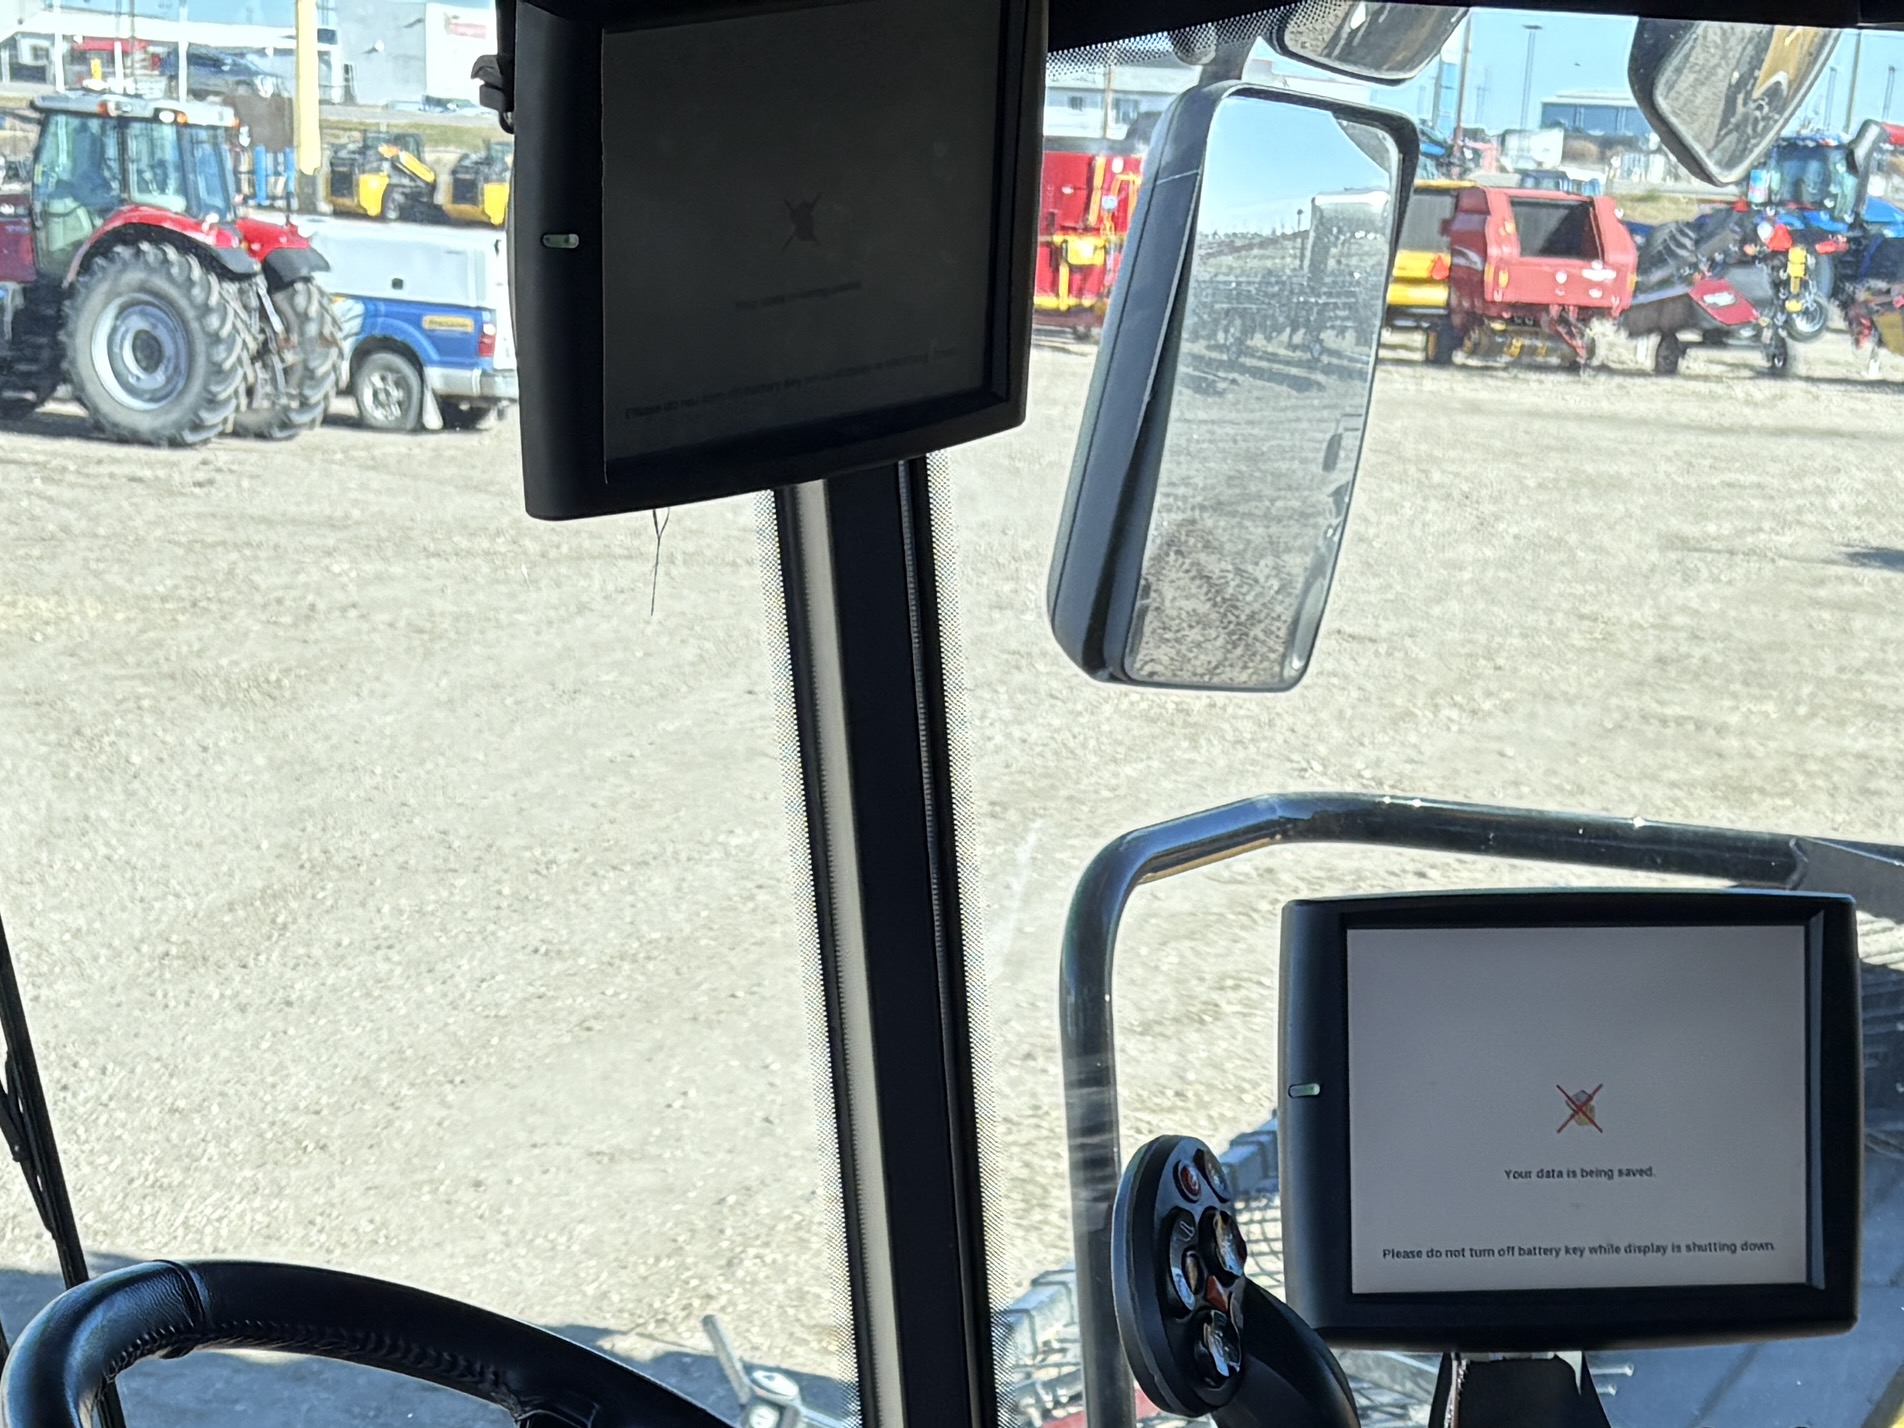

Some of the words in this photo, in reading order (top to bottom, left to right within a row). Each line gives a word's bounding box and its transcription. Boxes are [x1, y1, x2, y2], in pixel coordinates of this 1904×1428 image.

[1504, 1168, 1532, 1180] Your
[1536, 1167, 1564, 1179] data
[1566, 1167, 1577, 1179] is
[1580, 1166, 1614, 1181] being
[1617, 1165, 1657, 1179] saved.
[1382, 1248, 1423, 1260] Please
[1426, 1247, 1443, 1259] do
[1445, 1246, 1466, 1259] not
[1469, 1246, 1495, 1258] turn
[1498, 1245, 1516, 1258] off
[1518, 1244, 1561, 1259] battery
[1564, 1244, 1586, 1259] key
[1588, 1242, 1621, 1255] while
[1624, 1241, 1669, 1256] display
[1671, 1241, 1682, 1253] is
[1685, 1240, 1738, 1255] shutting
